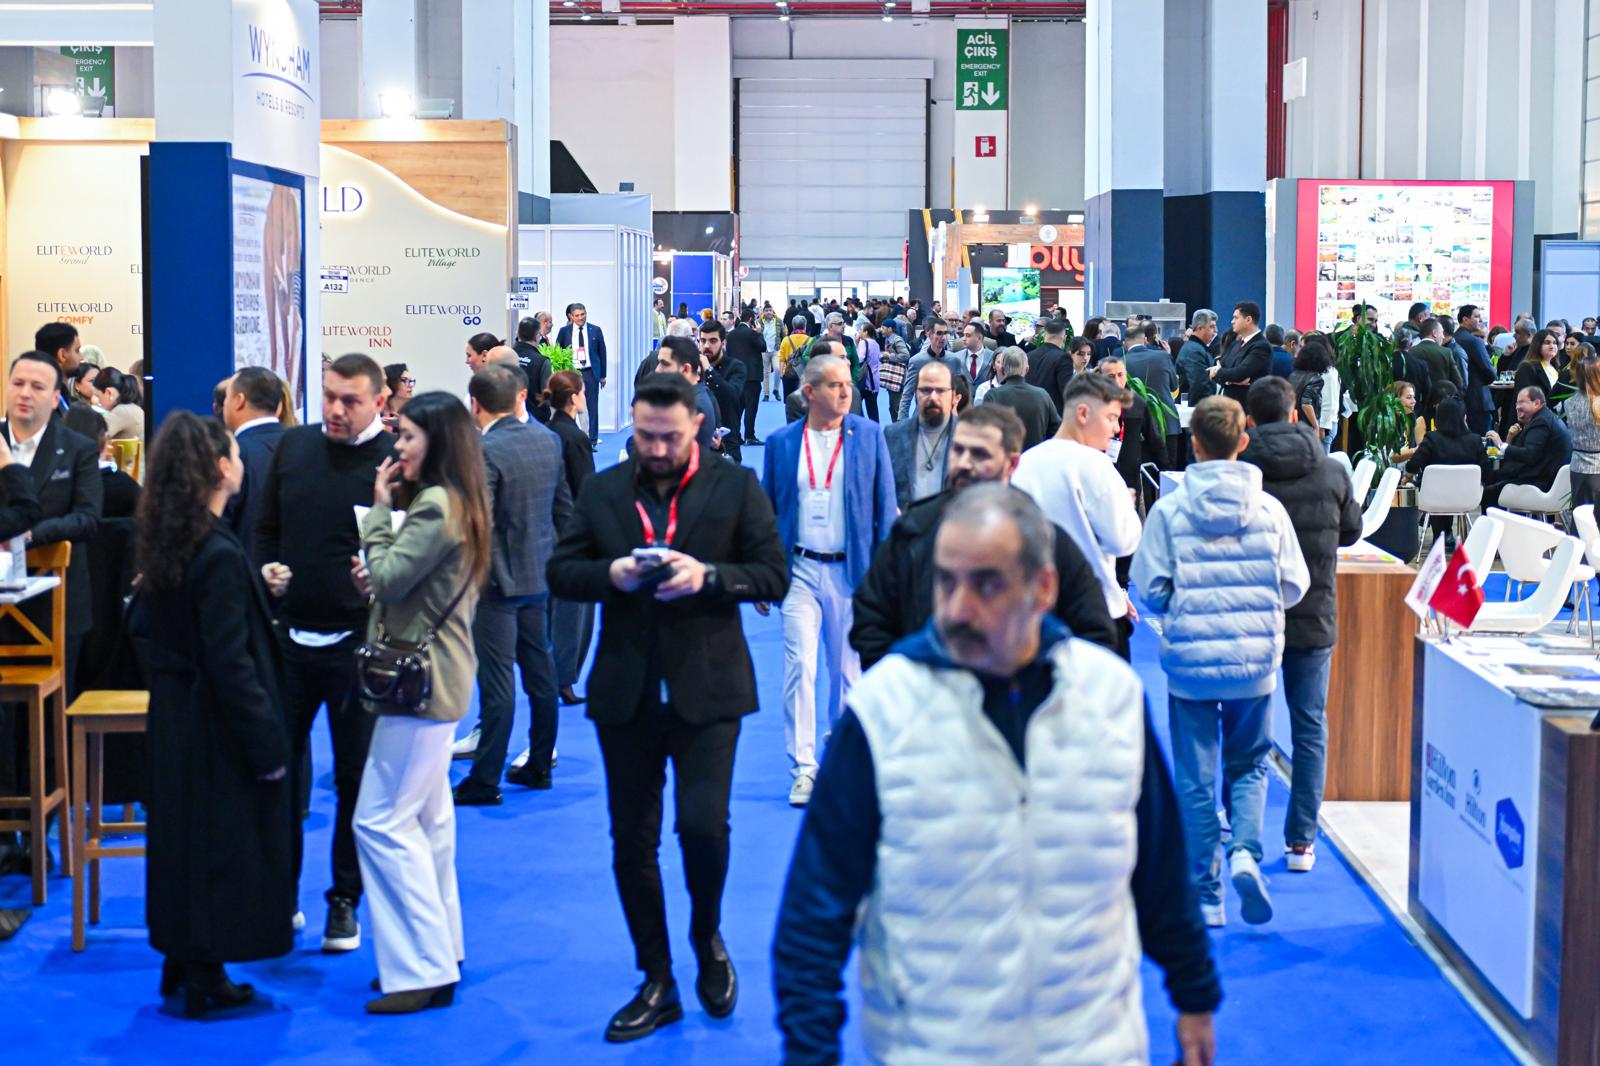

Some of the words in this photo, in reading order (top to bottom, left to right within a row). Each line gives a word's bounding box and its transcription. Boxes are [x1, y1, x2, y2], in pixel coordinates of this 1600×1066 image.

[966, 32, 996, 45] ACİL
[247, 23, 312, 84] WYNHAM
[964, 46, 998, 59] ÇIKIŞ
[36, 245, 113, 256] ELITEWORLD
[404, 247, 481, 258] ELITEWORLD
[427, 258, 457, 269] Village
[1029, 245, 1085, 282] olly
[323, 283, 343, 291] A132
[37, 302, 113, 313] ELITEWORLD
[405, 304, 482, 315] ELITEWORLD
[57, 315, 94, 324] COMFY
[463, 316, 482, 326] GO
[321, 325, 392, 337] LITEWORLD
[368, 337, 393, 348] INN
